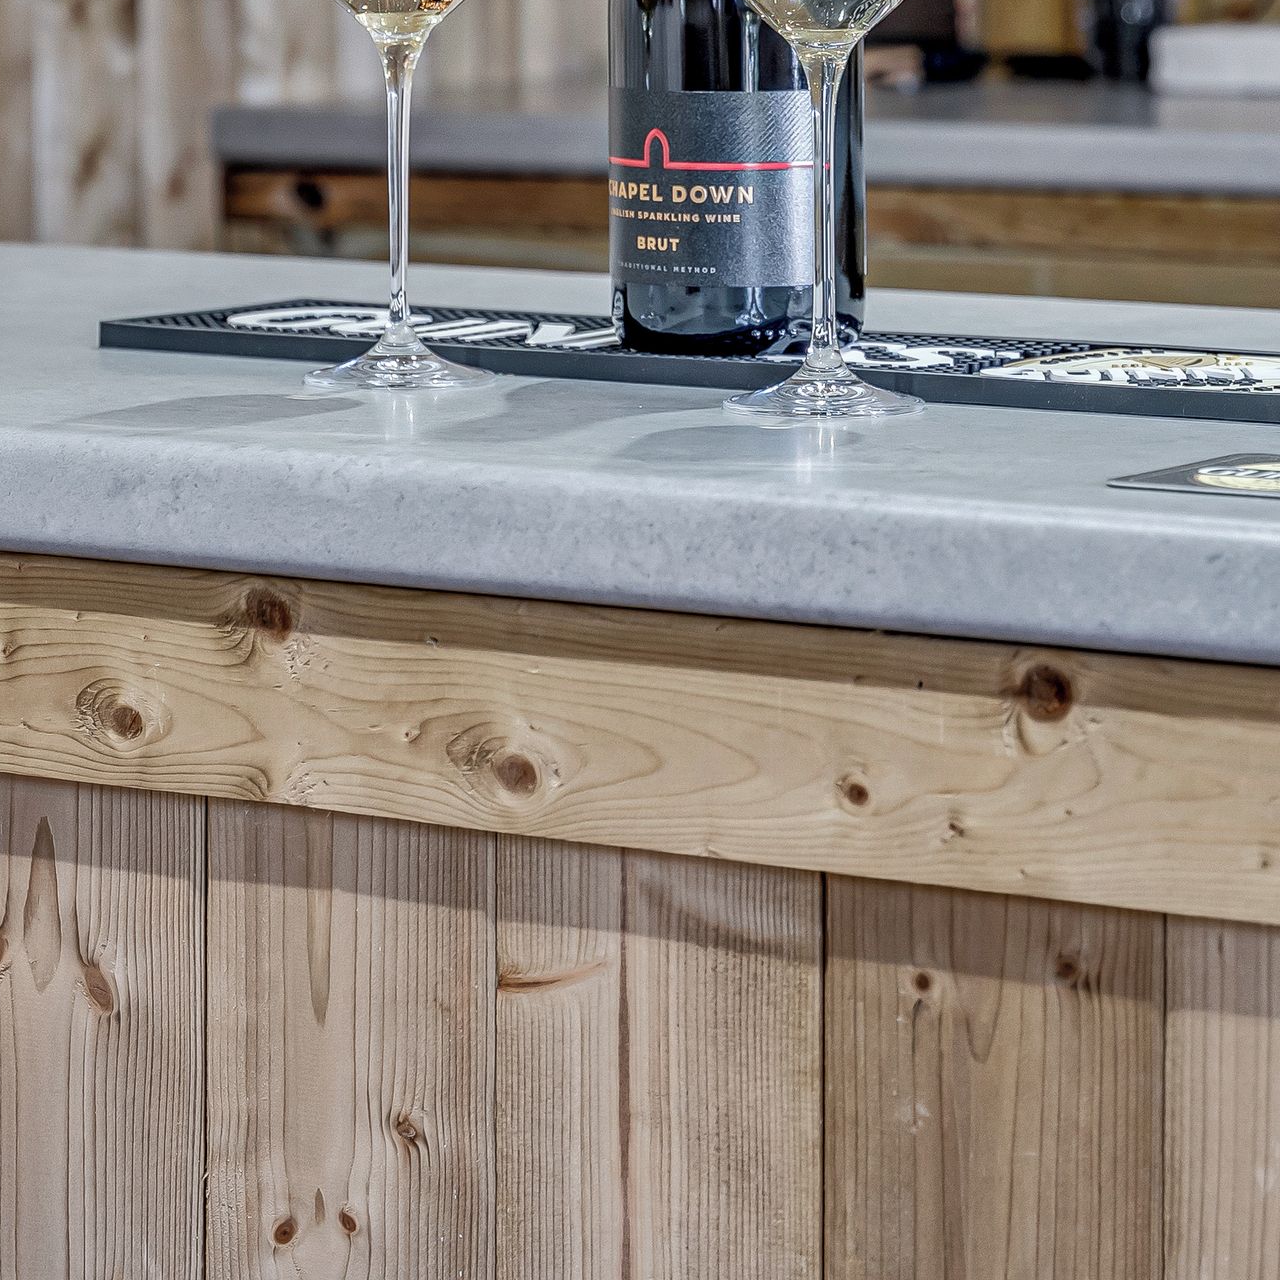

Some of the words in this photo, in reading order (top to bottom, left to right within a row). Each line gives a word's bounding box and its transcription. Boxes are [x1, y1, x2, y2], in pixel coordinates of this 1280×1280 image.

[608, 179, 663, 202] CHAPEL
[672, 185, 754, 204] DOWN
[637, 211, 700, 223] SPARKLING
[705, 214, 741, 224] WINE
[636, 235, 680, 252] BRUT
[618, 262, 668, 273] RADITIONAL
[673, 266, 717, 274] METHOD
